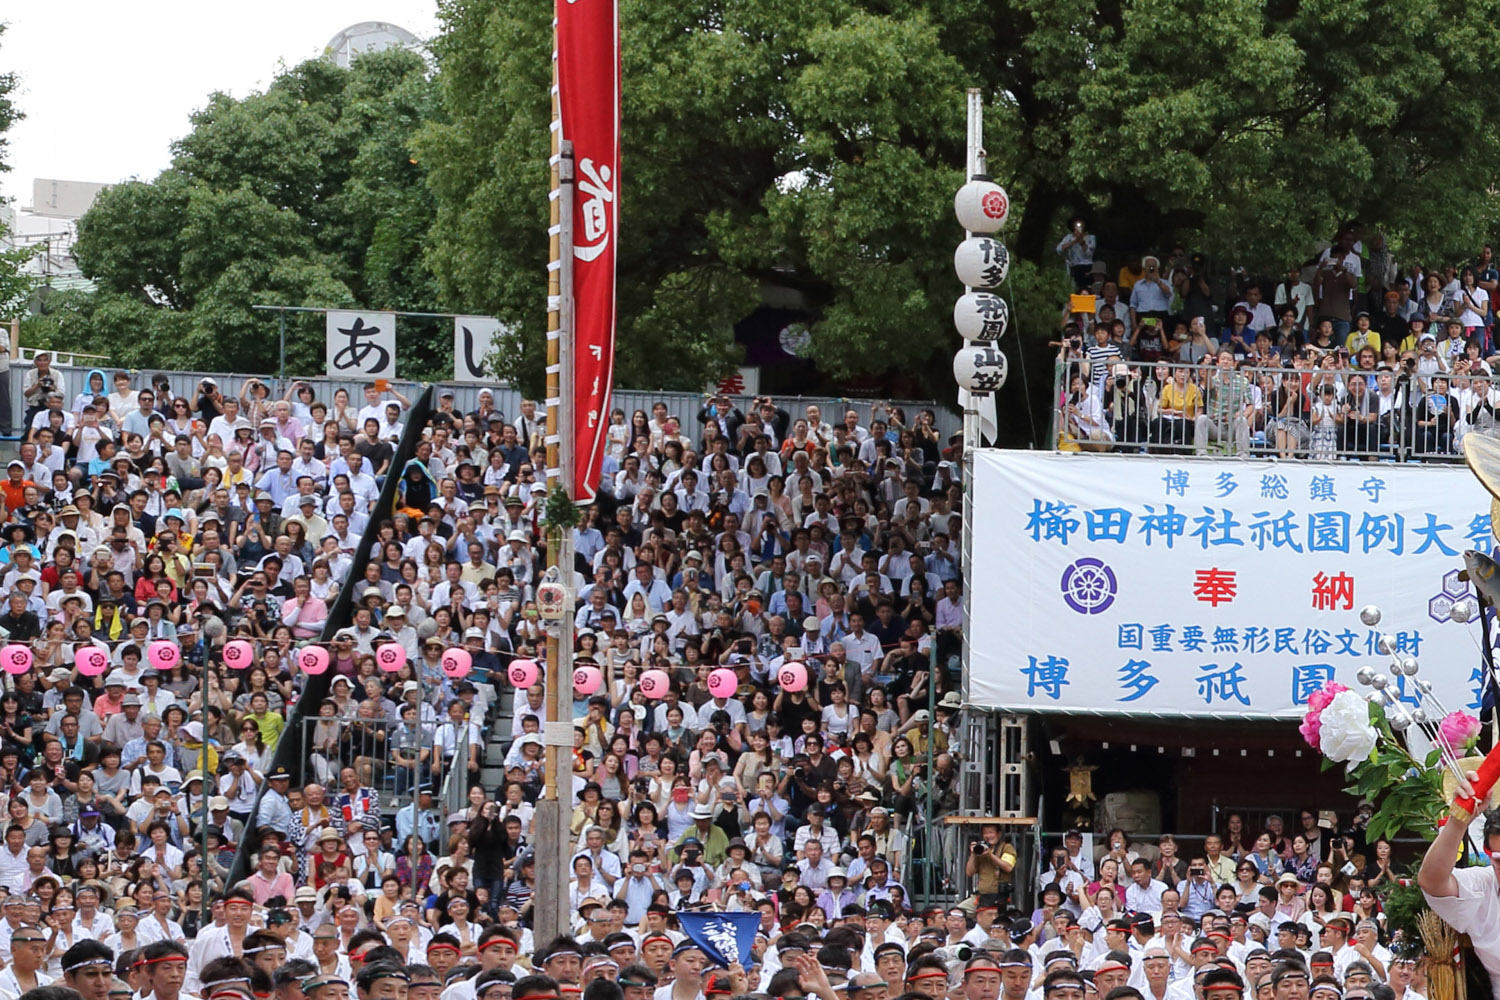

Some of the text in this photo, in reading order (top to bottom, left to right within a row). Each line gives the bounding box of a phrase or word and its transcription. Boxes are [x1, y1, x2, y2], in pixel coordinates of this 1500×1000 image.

[333, 317, 390, 374] あ
[1162, 469, 1386, 504] 博多総鎮守
[1117, 622, 1424, 658] 国重要無形民俗文化財
